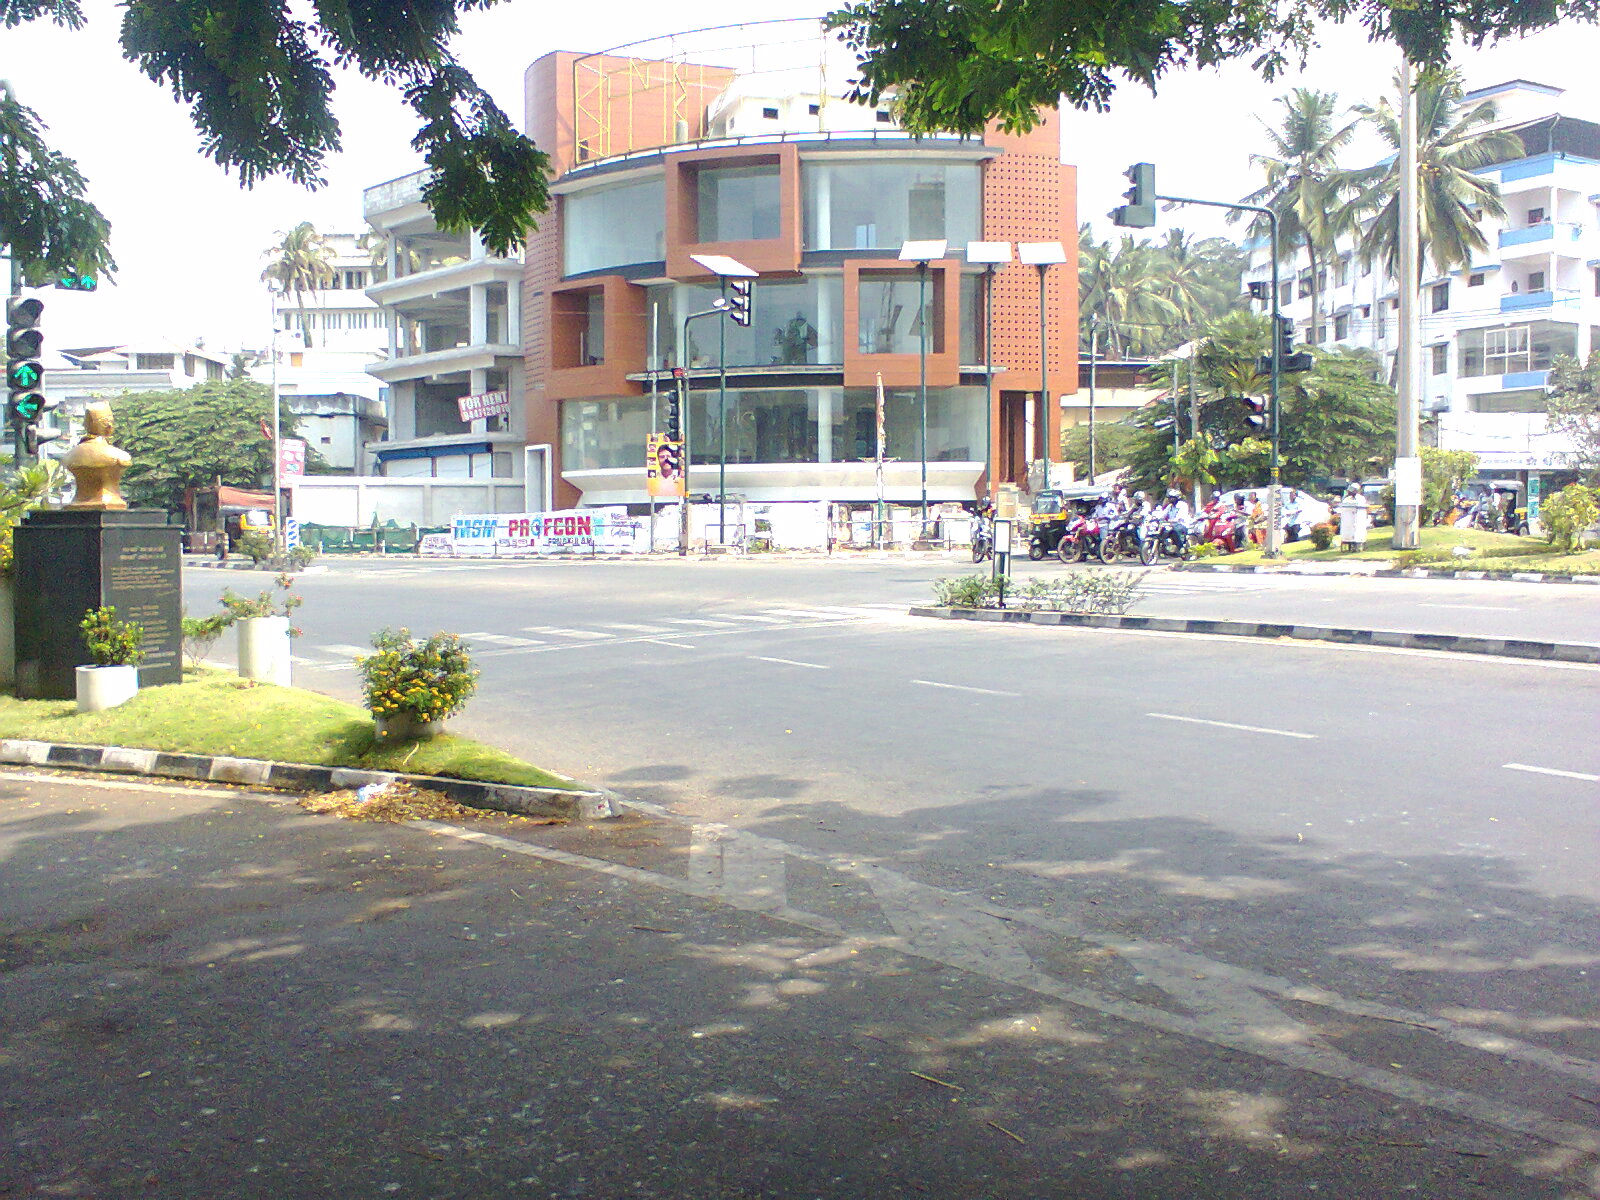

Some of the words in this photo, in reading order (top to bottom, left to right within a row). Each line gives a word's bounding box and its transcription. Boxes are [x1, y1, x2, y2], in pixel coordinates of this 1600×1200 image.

[460, 396, 481, 411] FOR
[481, 390, 508, 406] RENT
[508, 515, 592, 537] PROFCON
